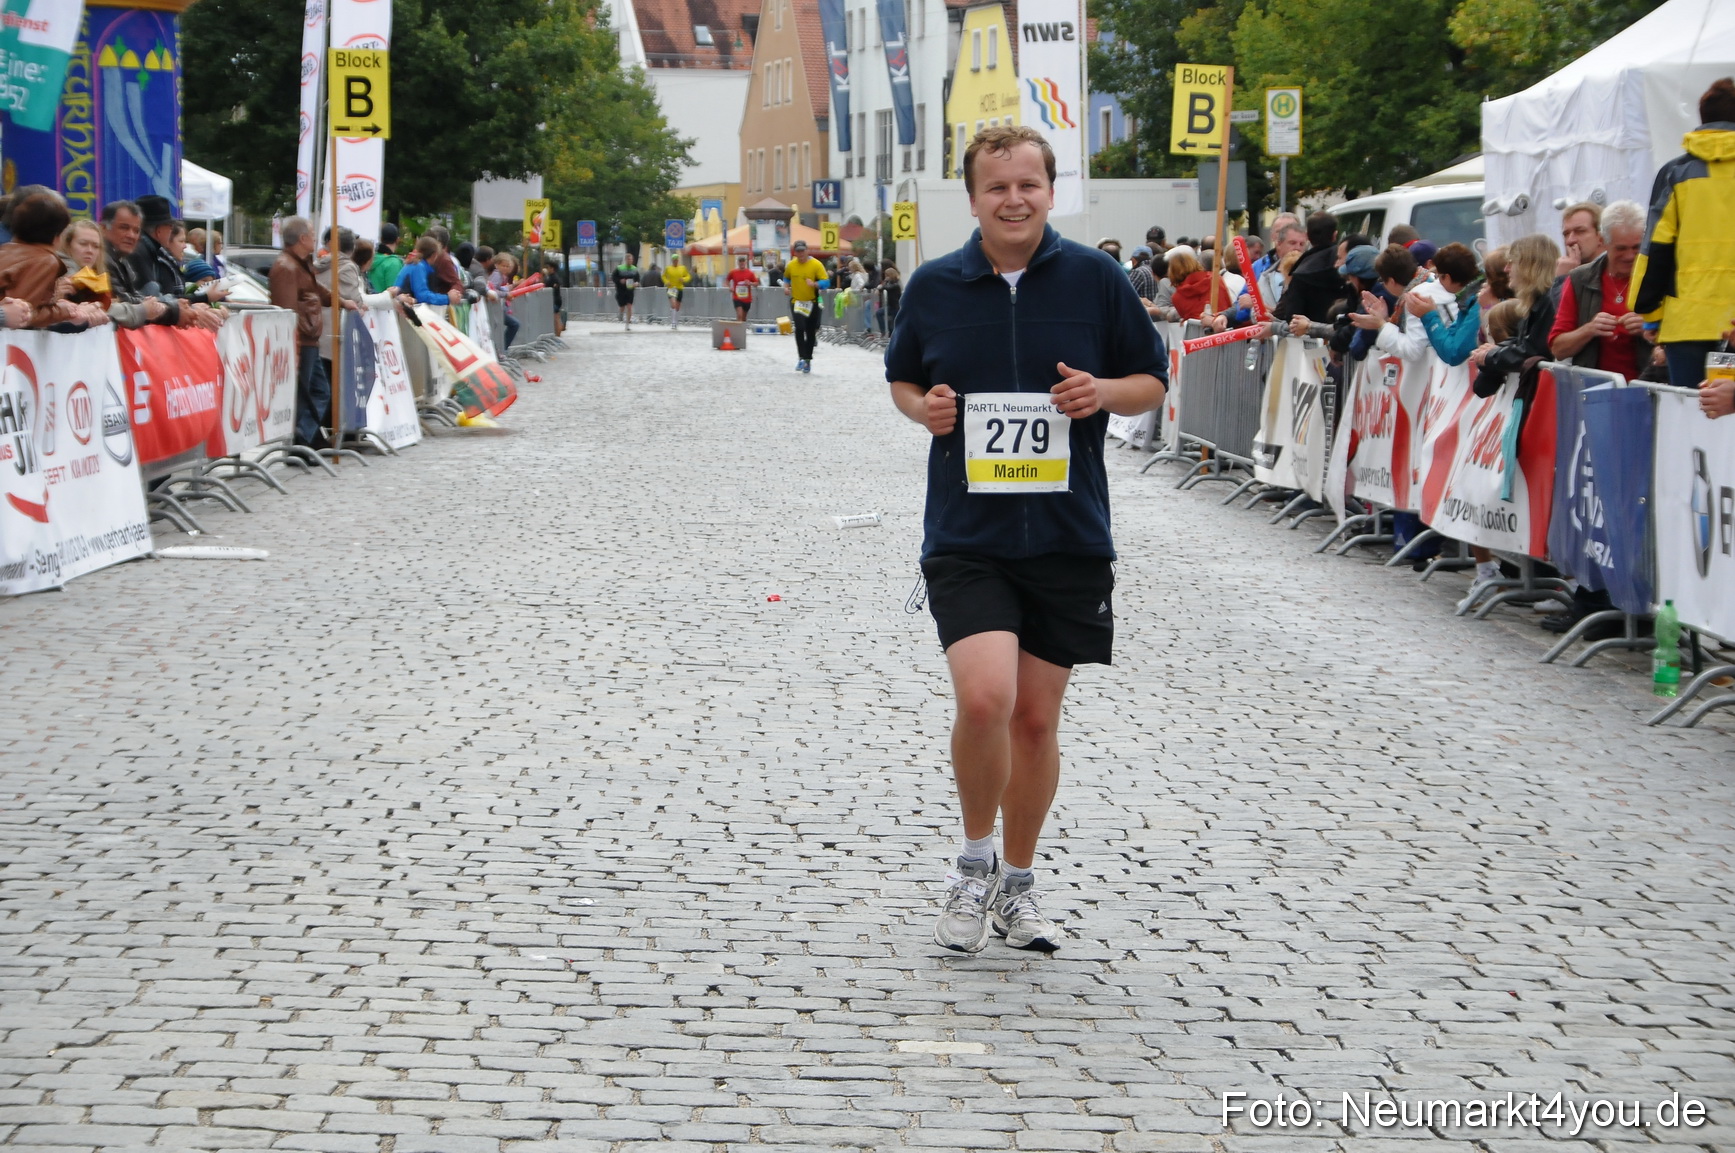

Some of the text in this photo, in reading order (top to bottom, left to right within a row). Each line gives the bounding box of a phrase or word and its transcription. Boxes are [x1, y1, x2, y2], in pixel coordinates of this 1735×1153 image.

[336, 52, 381, 68] Block
[1182, 68, 1226, 86] Block
[345, 75, 374, 118] B
[1187, 91, 1216, 134] B
[898, 213, 911, 232] C
[667, 239, 684, 247] TAXI
[825, 230, 836, 244] D
[1189, 333, 1236, 351] Audi BKK
[967, 403, 1052, 413] PARTL Neumarkt
[985, 418, 1050, 454] 279
[994, 464, 1038, 478] Martin
[1481, 505, 1518, 533] Radio
